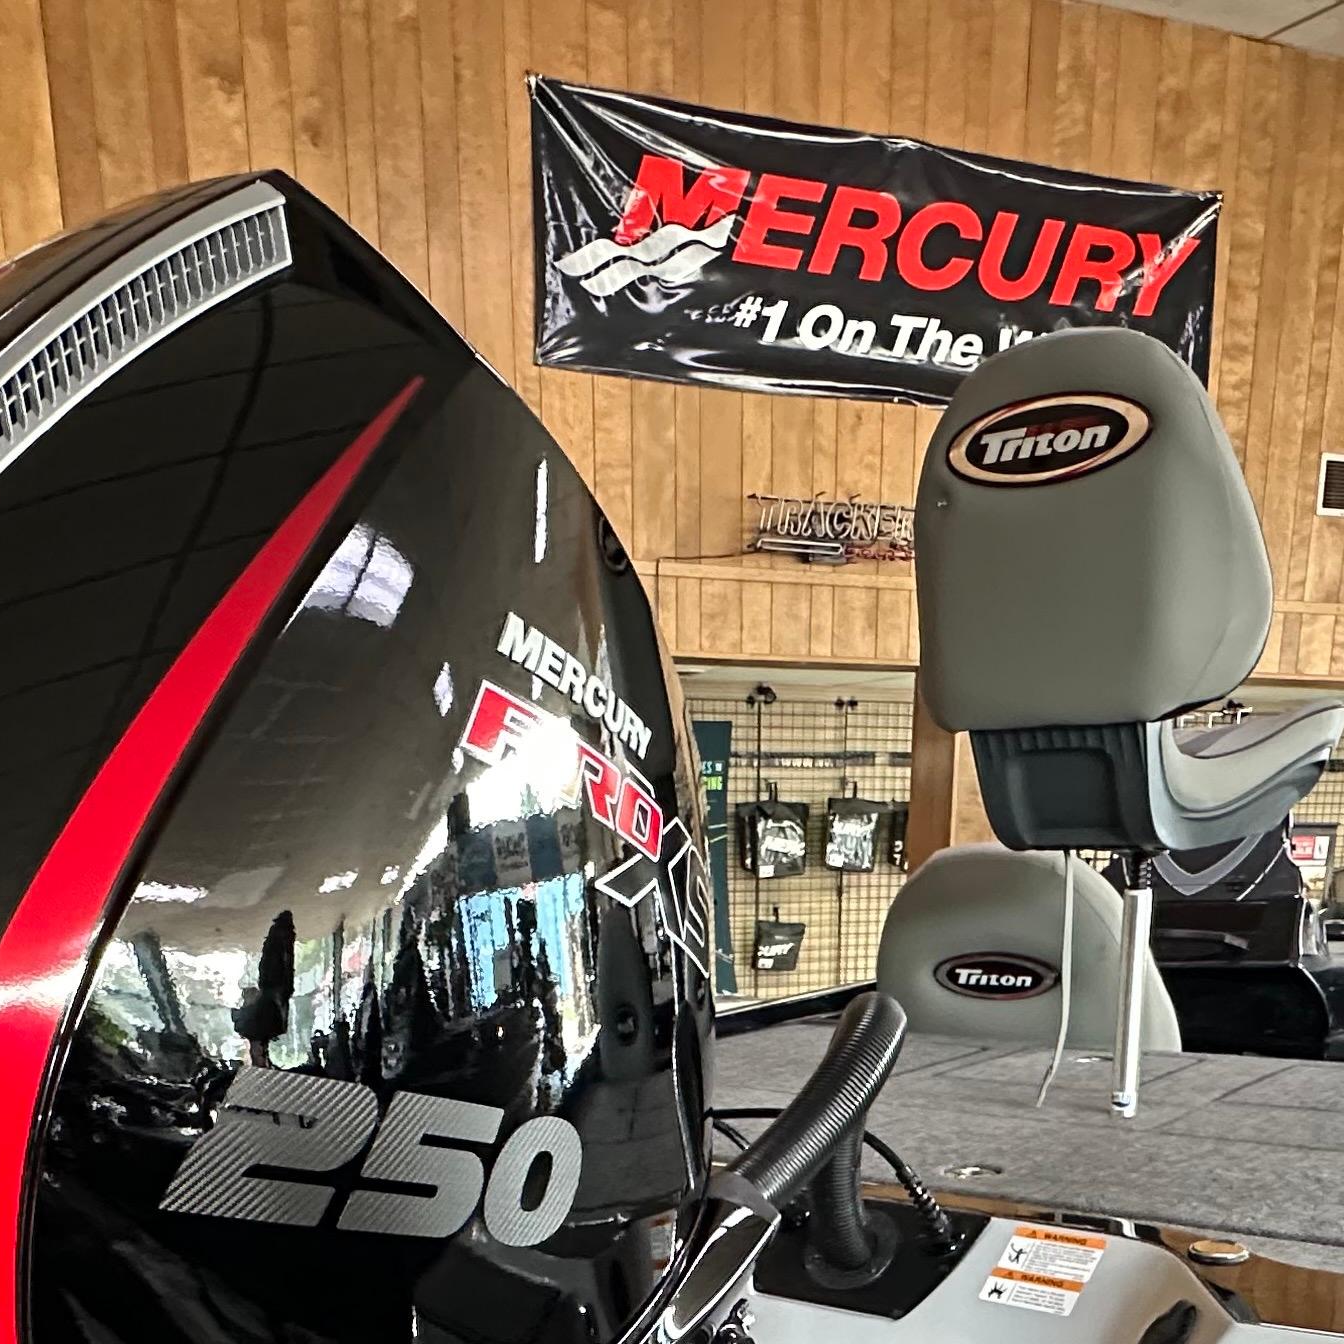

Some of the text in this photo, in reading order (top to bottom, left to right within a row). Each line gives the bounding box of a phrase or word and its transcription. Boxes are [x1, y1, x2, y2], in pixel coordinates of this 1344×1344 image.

[617, 154, 1200, 317] MERCURY
[733, 297, 787, 346] #1
[797, 304, 879, 356] On
[888, 313, 981, 364] The
[980, 424, 1111, 466] Triton
[496, 610, 654, 760] MERCURY
[954, 968, 1034, 988] Triton
[157, 1065, 584, 1248] 250
[1044, 1233, 1088, 1246] WARNING
[1020, 1274, 1065, 1289] WARNING
